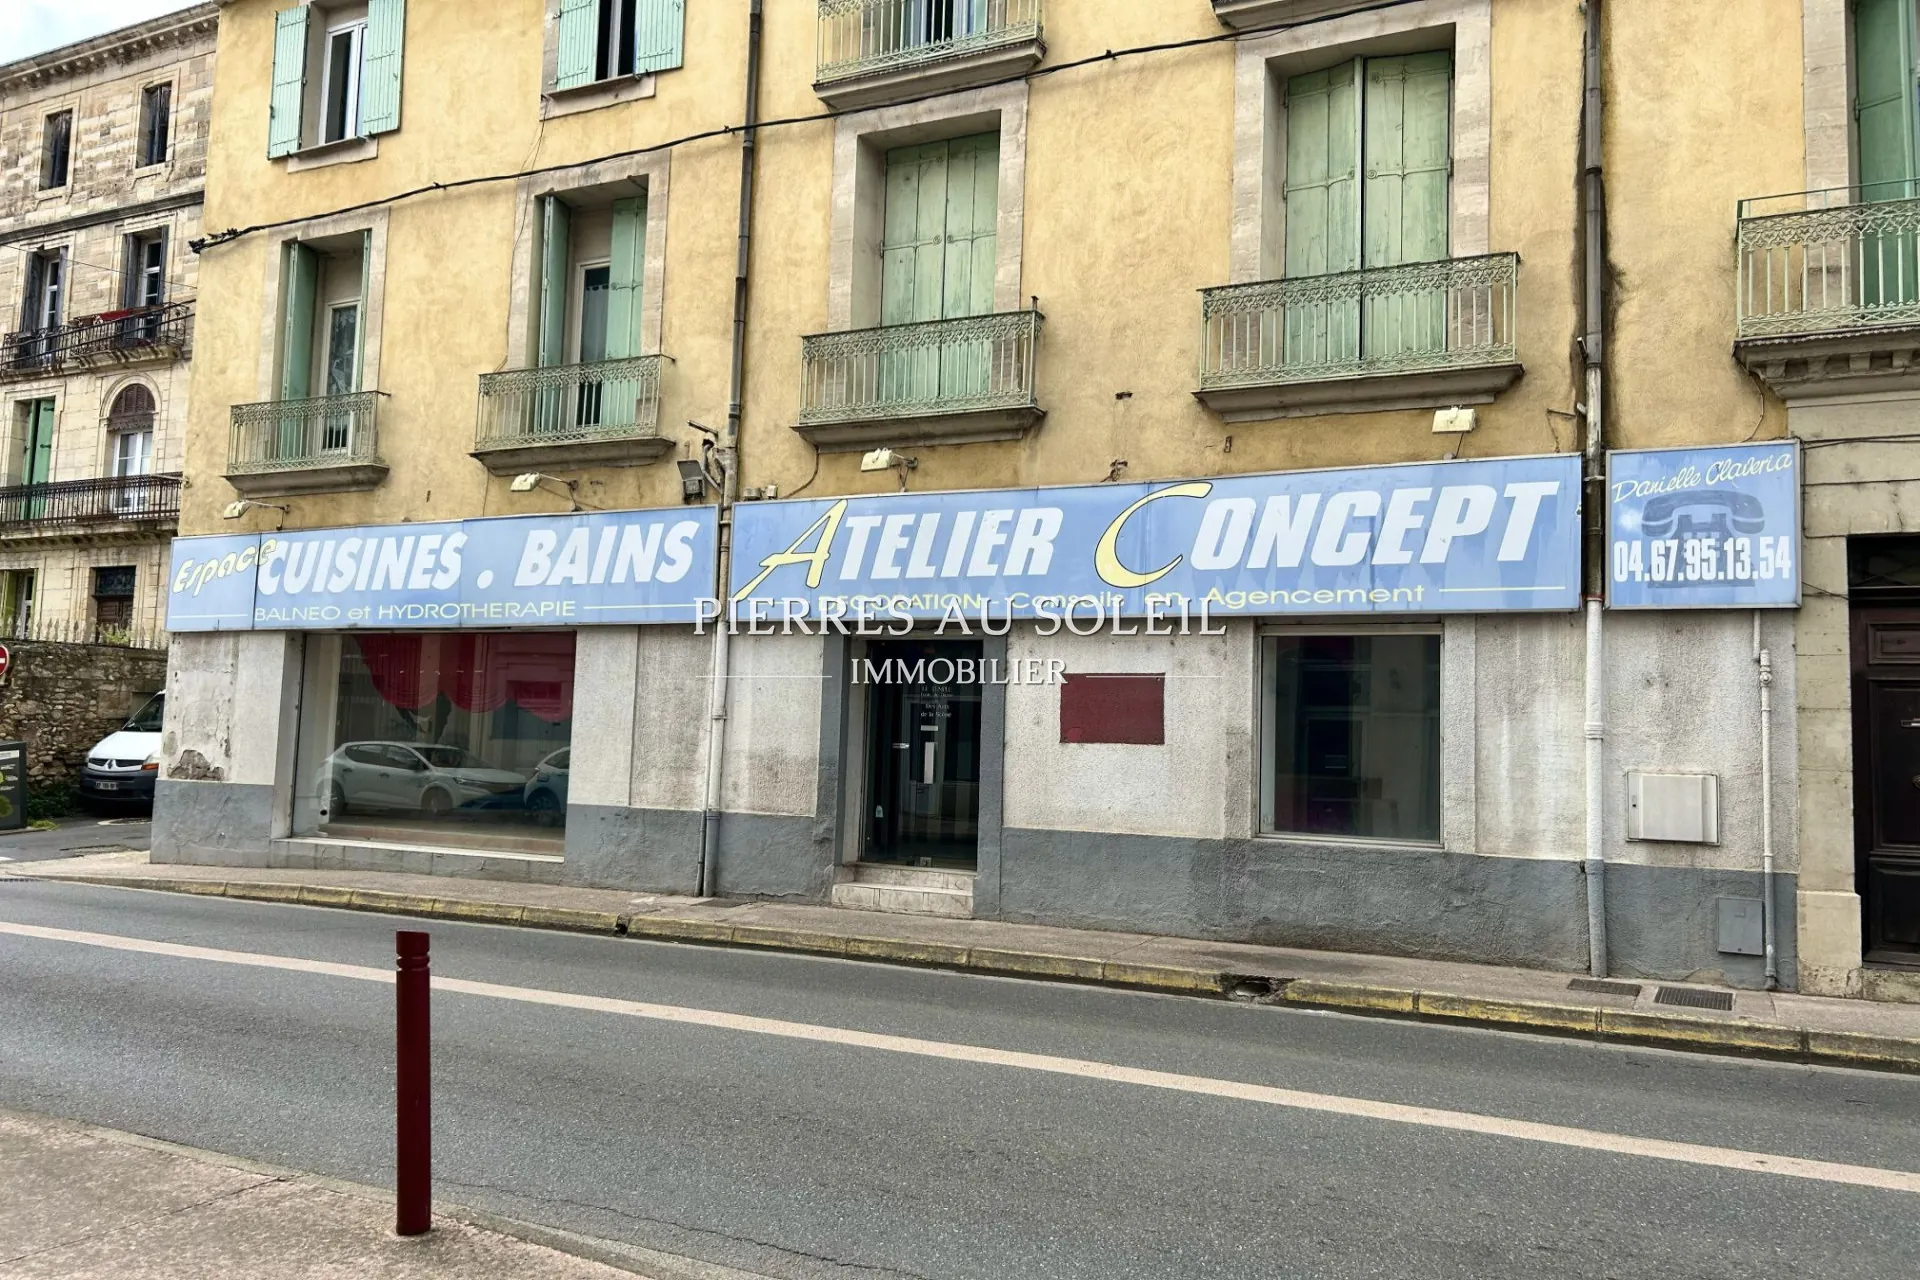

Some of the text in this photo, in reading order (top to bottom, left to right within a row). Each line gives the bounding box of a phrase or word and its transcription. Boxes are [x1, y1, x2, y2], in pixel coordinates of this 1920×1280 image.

[1612, 465, 1701, 503] Danielle
[257, 531, 468, 595] CUISINES
[514, 520, 700, 587] BAINS
[735, 482, 1560, 601] ATELIER CONCEPT
[1613, 535, 1792, 582] 04.67.95.13.54
[172, 538, 278, 598] Espace
[255, 601, 576, 621] BALNEO et HYDROTHERAPIE
[1205, 584, 1424, 609] Agencement
